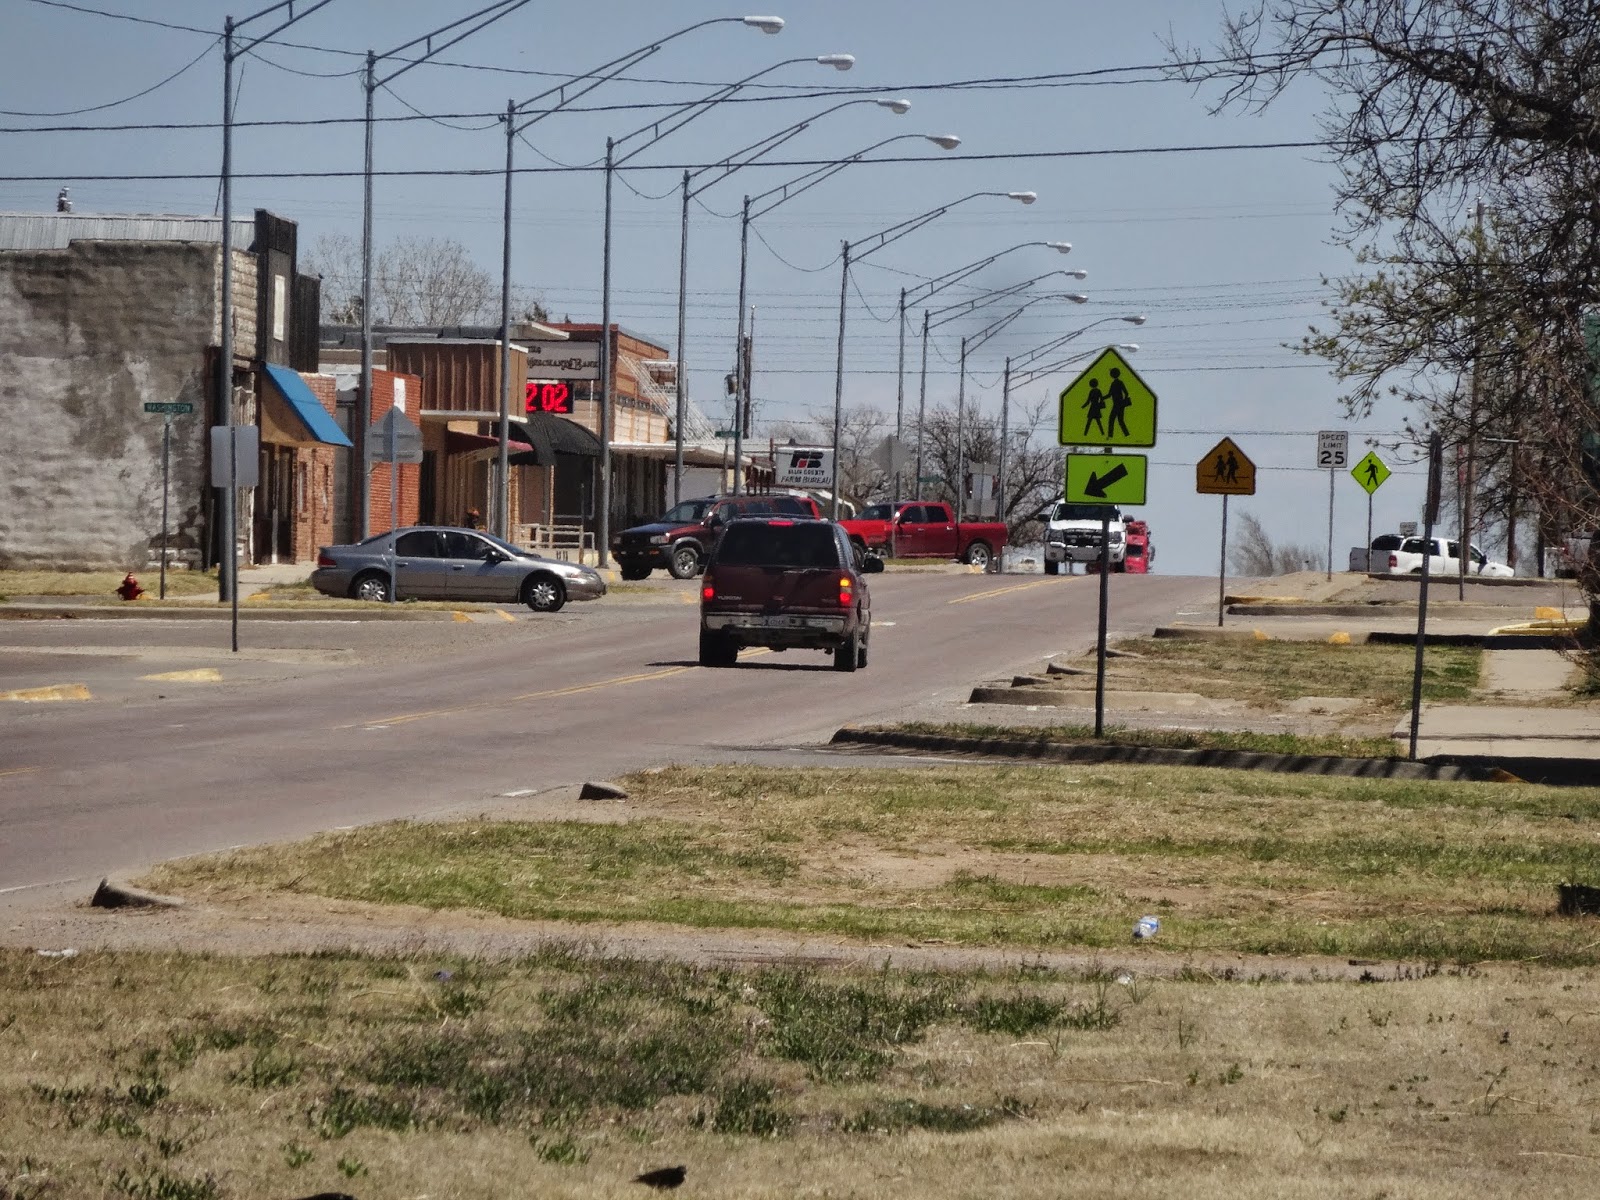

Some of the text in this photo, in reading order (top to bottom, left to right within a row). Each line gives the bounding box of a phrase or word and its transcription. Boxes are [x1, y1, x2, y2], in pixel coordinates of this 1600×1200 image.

[146, 403, 191, 412] WASHINGTON
[1320, 450, 1345, 465] 25
[802, 476, 831, 484] BUREAU
